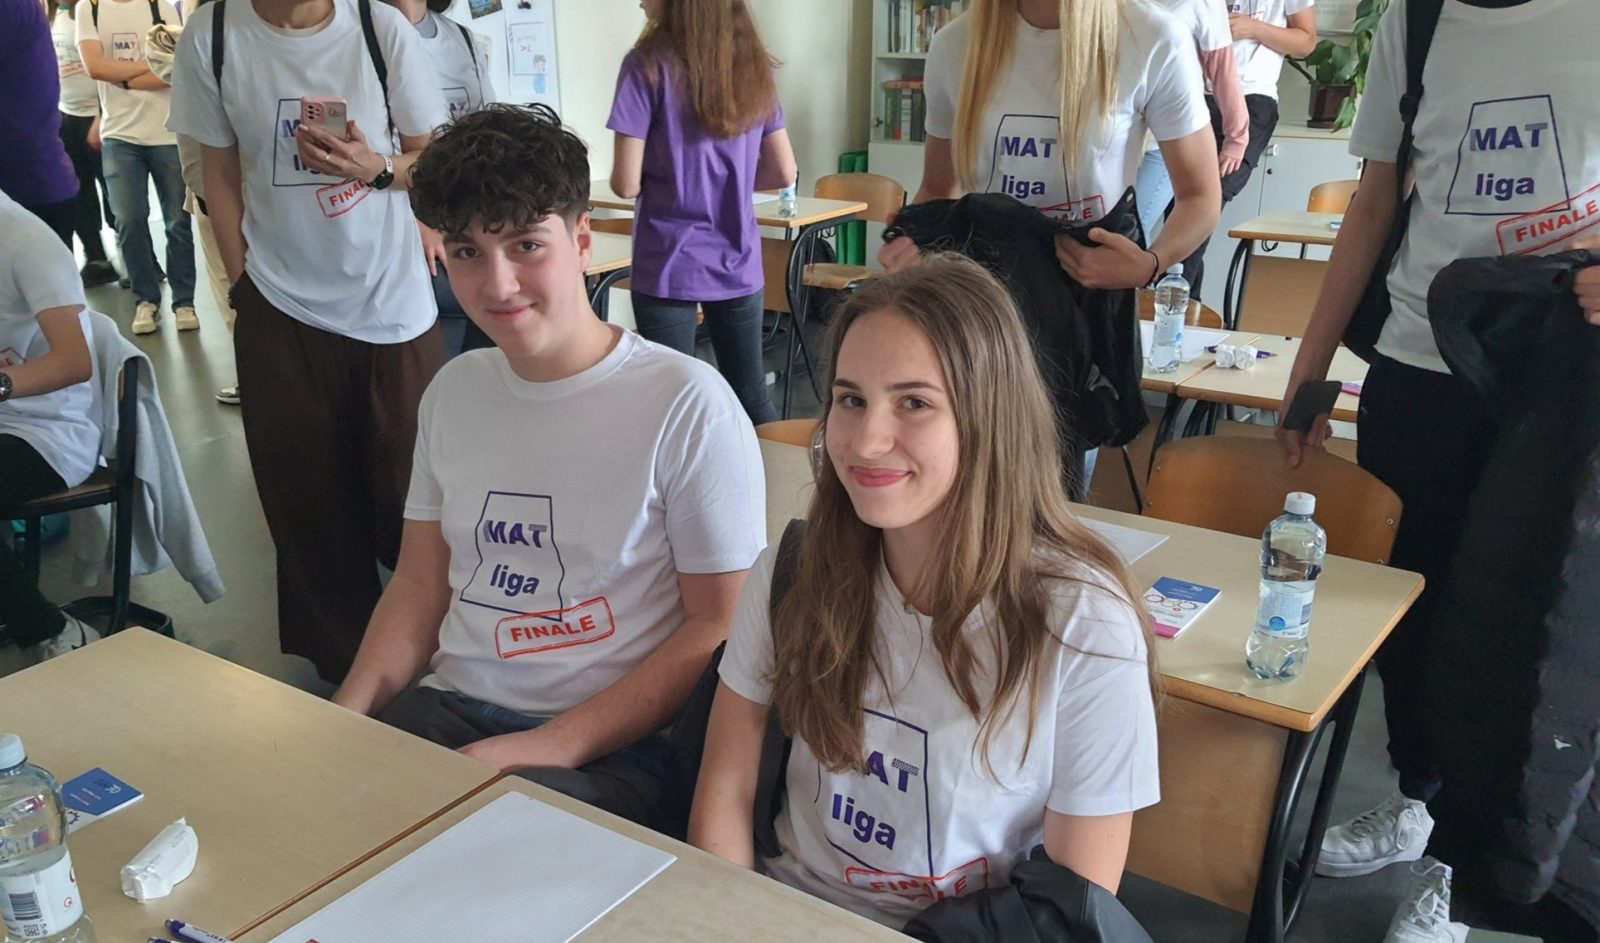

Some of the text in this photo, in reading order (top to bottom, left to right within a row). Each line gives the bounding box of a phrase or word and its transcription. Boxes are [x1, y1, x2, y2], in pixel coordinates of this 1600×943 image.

[1000, 136, 1057, 158] MAT
[1470, 122, 1548, 151] MAT
[329, 181, 366, 206] FINAL
[1001, 174, 1046, 199] liga
[1475, 173, 1535, 201] liga
[1515, 199, 1598, 242] FINALE
[483, 519, 548, 548] MAT
[489, 563, 540, 597] liga
[510, 614, 596, 642] FINALE
[864, 750, 919, 792] AT
[832, 793, 896, 850] liga
